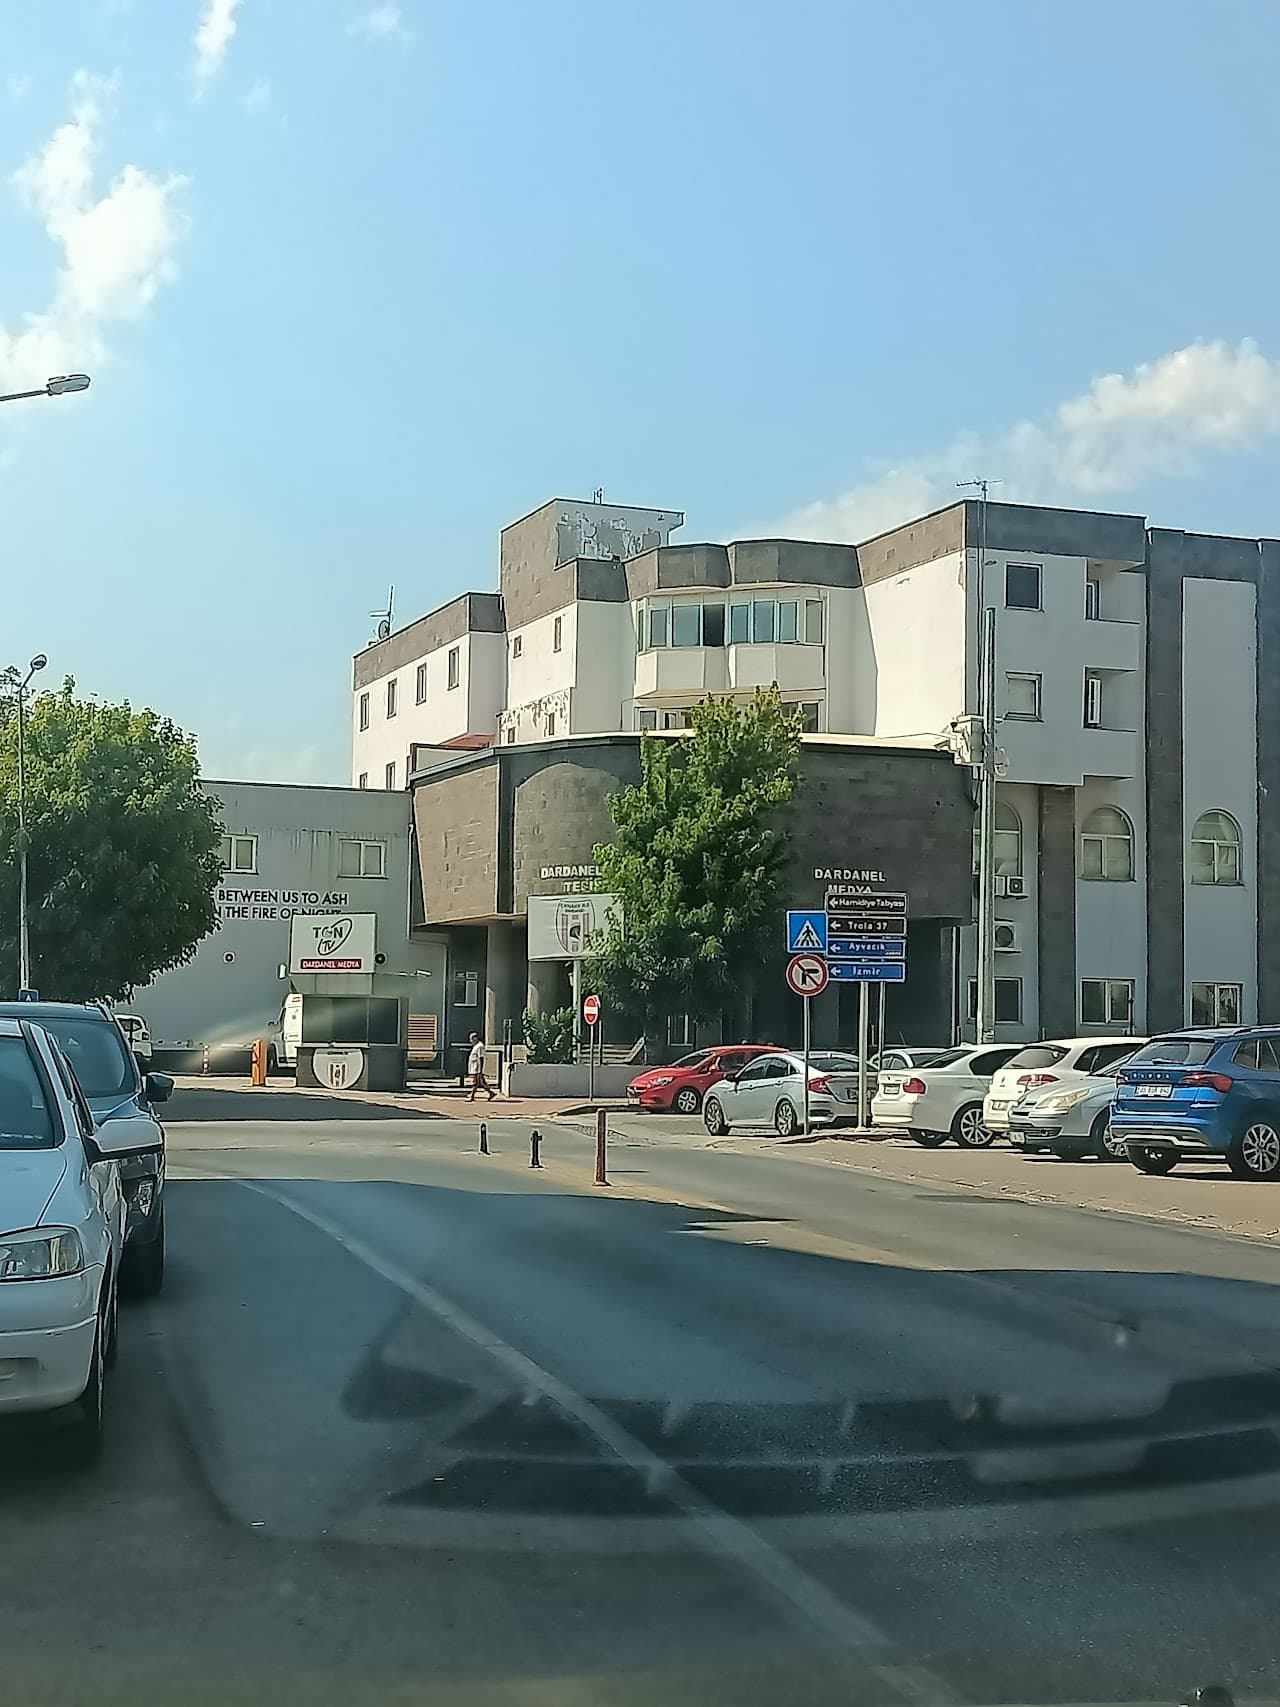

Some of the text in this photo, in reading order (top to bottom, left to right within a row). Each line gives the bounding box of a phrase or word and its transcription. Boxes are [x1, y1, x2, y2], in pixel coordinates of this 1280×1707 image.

[541, 865, 602, 879] DARDANEL
[814, 868, 886, 882] DARDANEL
[828, 884, 873, 893] MEDYA
[218, 889, 348, 905] BETWEEN US TO ASH
[225, 906, 249, 919] THE
[252, 907, 278, 919] FIRE
[280, 908, 298, 919] OF
[876, 921, 888, 930] 37
[322, 940, 336, 953] TV
[337, 960, 360, 969] MEDYA
